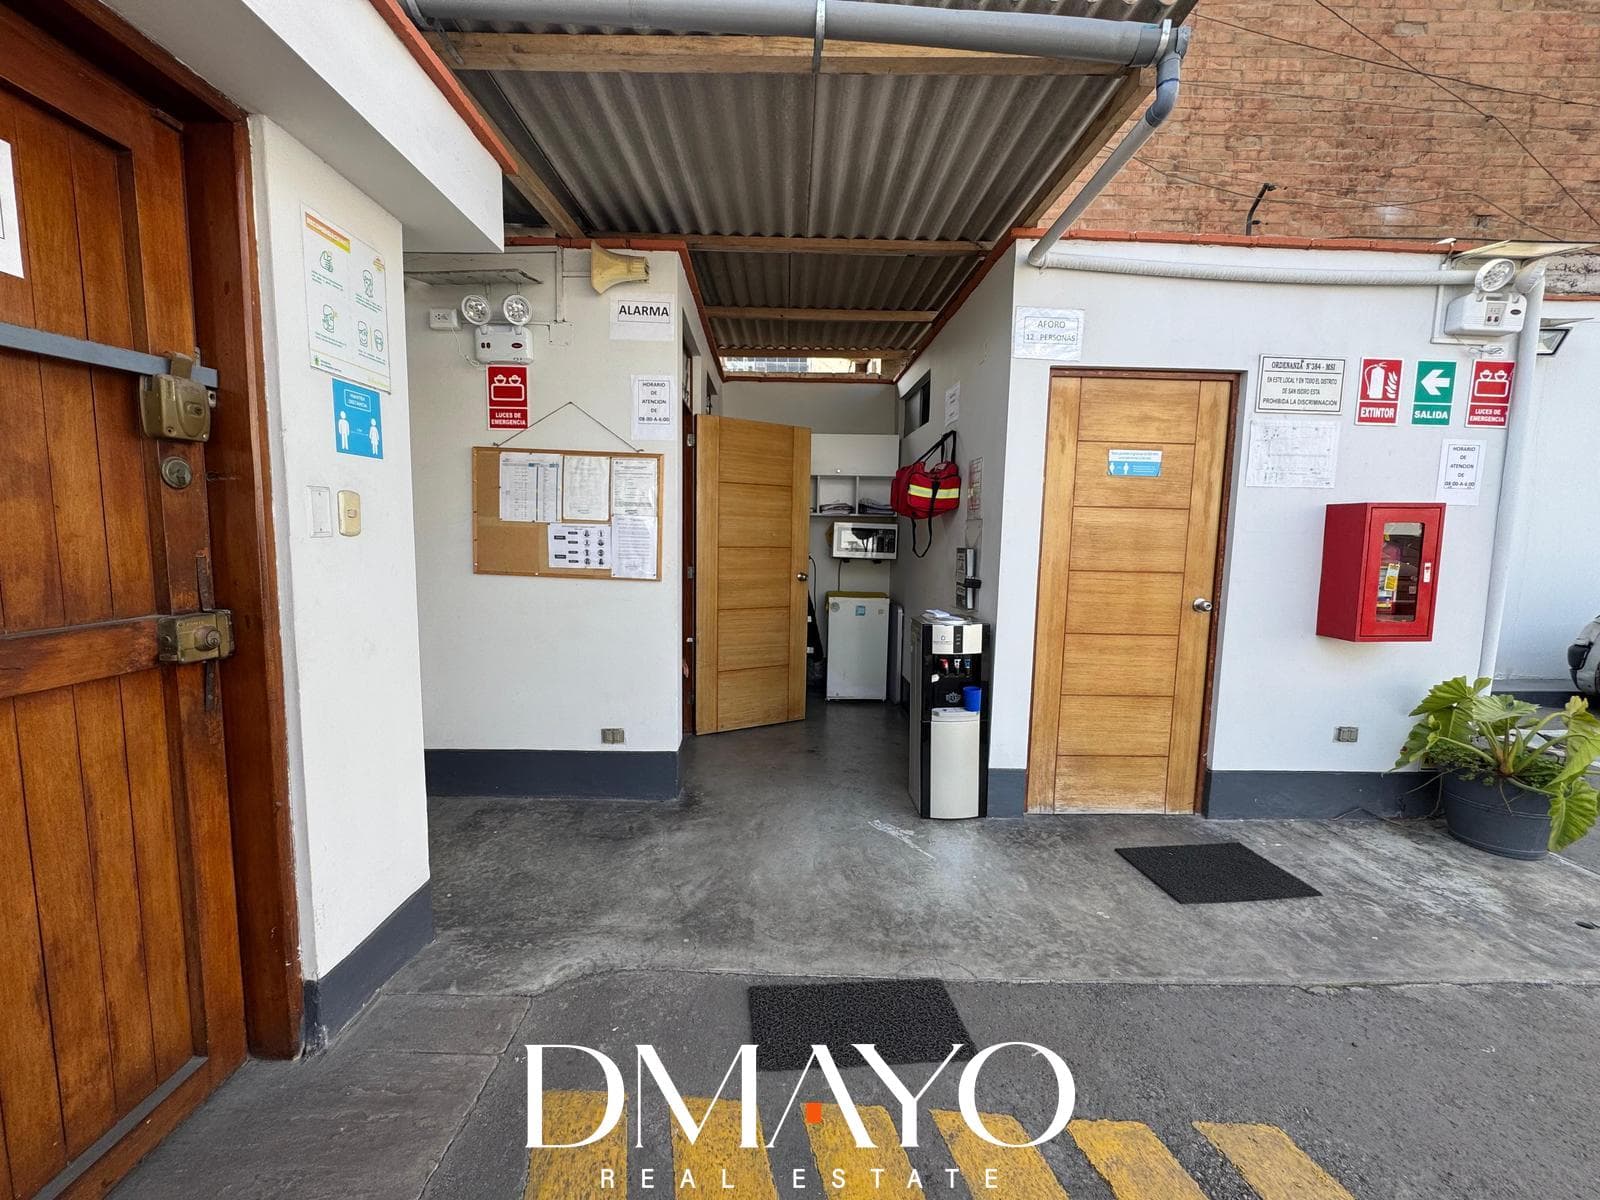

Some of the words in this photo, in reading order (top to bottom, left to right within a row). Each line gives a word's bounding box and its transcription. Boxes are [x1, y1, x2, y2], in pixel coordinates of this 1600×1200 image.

[618, 305, 669, 317] ALARMA
[1037, 320, 1066, 329] AFORO
[1026, 333, 1034, 341] 12
[1039, 333, 1076, 342] PERSONAS
[1271, 361, 1303, 370] ORDENANZA
[1273, 376, 1282, 384] ESTE
[1263, 397, 1289, 405] PROHIBIDA
[1360, 407, 1394, 419] EXTINTOR
[1414, 410, 1448, 420] SALIDA
[1469, 415, 1505, 423] EMERGENCIA
